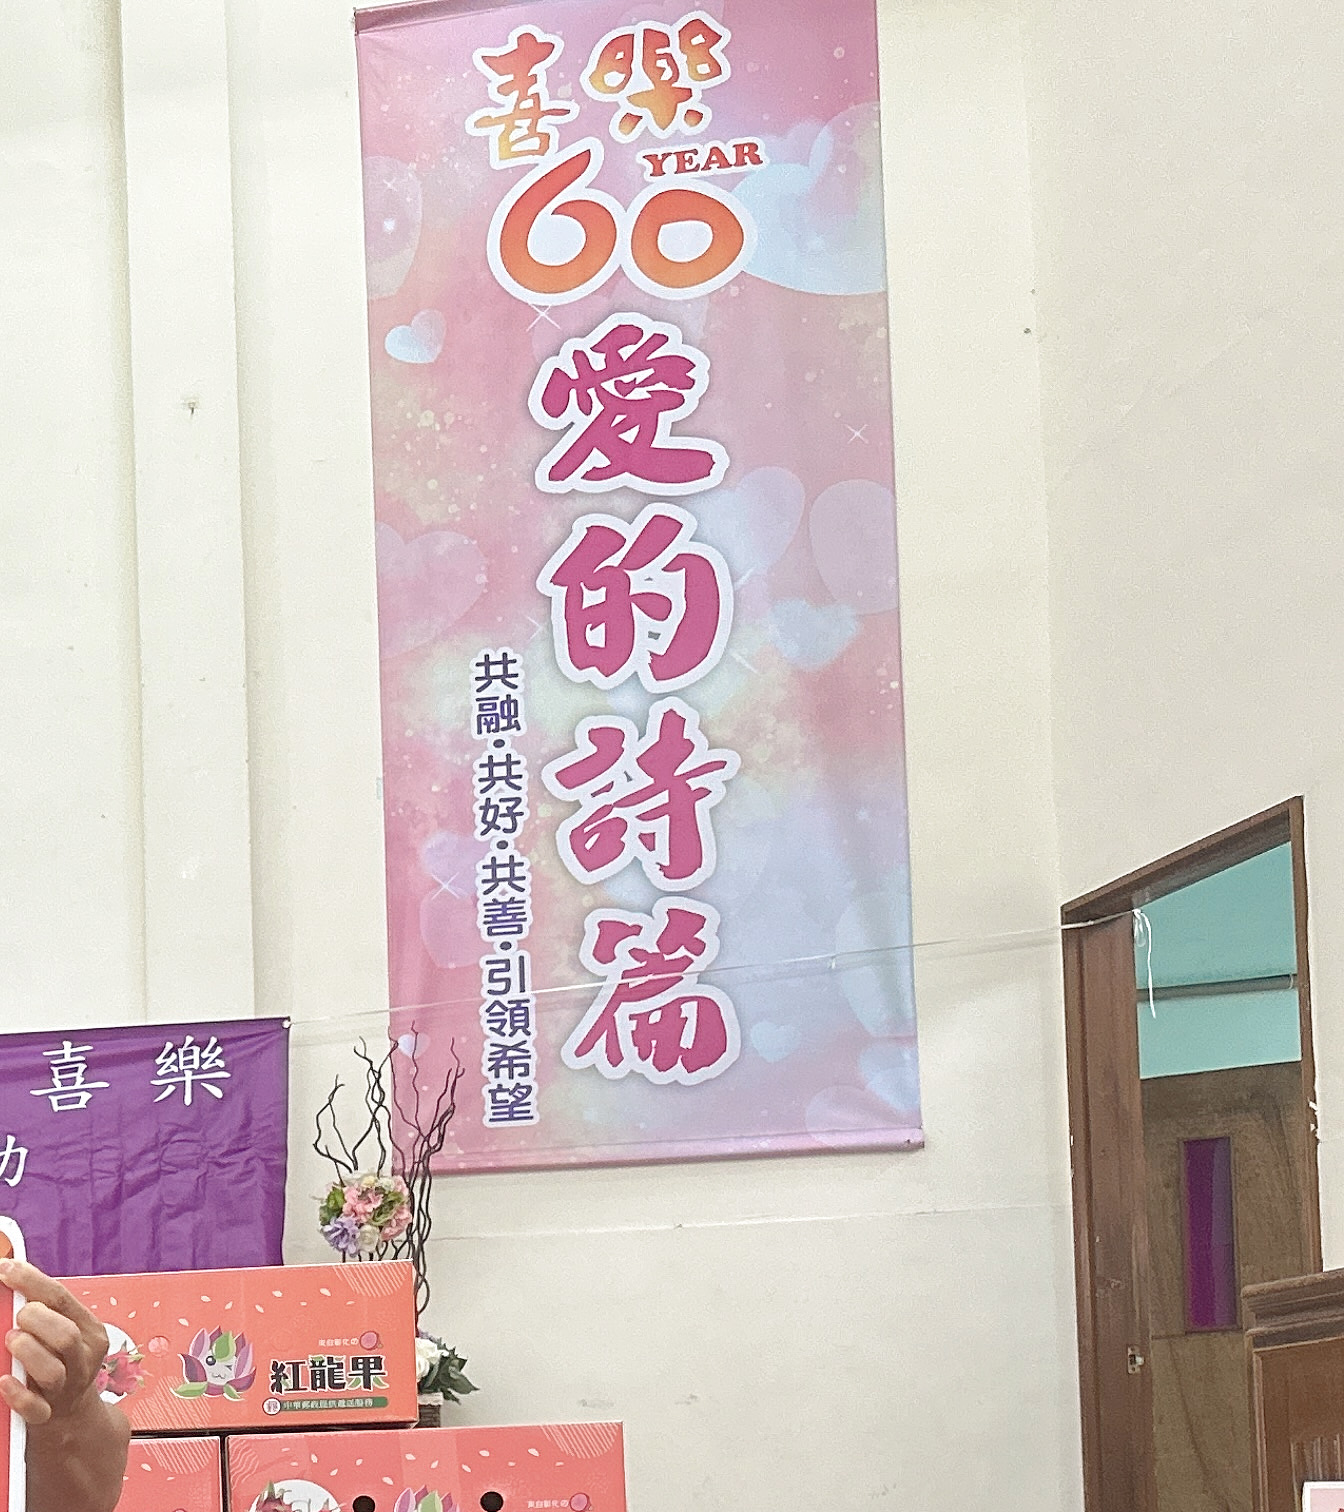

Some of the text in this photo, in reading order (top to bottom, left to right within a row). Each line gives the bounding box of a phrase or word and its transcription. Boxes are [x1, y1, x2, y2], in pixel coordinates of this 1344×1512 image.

[473, 17, 724, 160] 喜樂
[644, 141, 764, 177] YEAR
[498, 146, 745, 295] 60
[539, 322, 729, 1074] 愛的詩篇
[269, 1354, 390, 1396] 紅龍果
